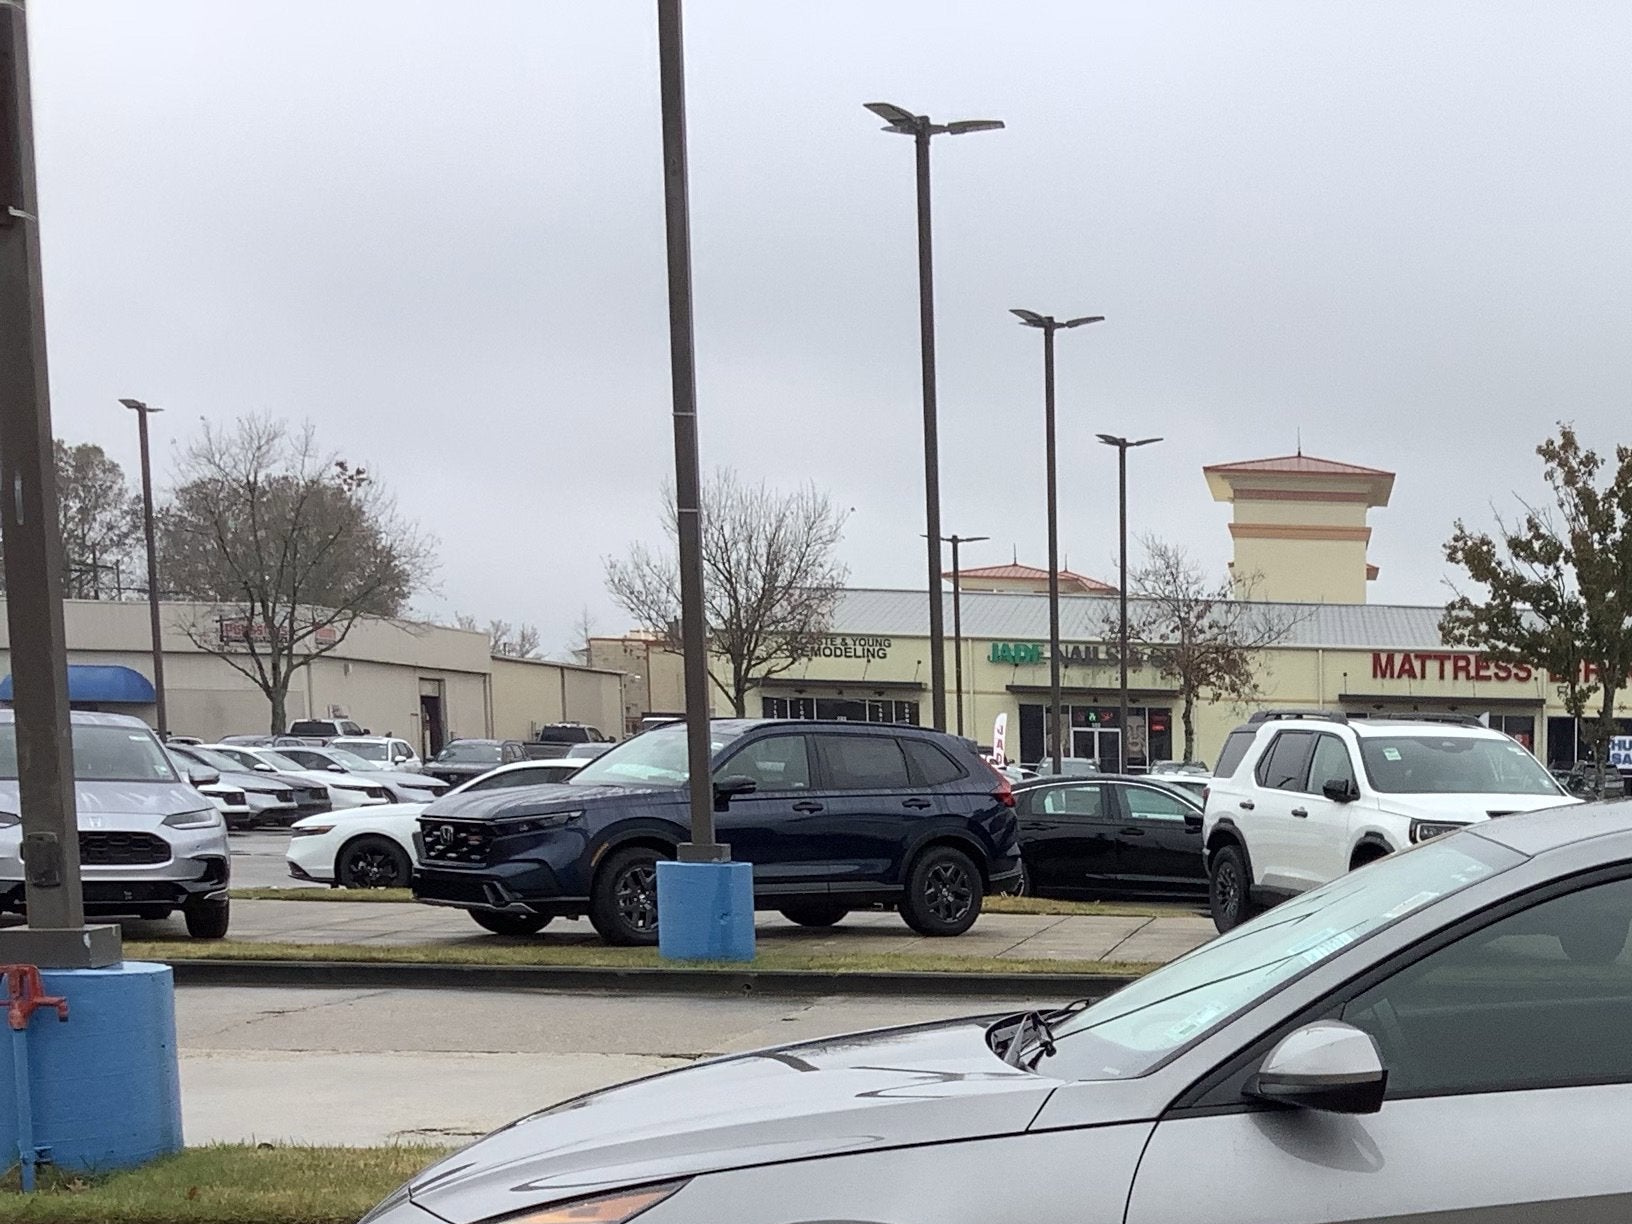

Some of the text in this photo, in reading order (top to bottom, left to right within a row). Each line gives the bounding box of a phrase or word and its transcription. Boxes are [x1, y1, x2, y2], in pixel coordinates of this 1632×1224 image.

[840, 638, 849, 647] &
[852, 638, 892, 649] YOUNG
[988, 642, 1046, 664] JADE
[1372, 652, 1533, 683] MATTRESS
